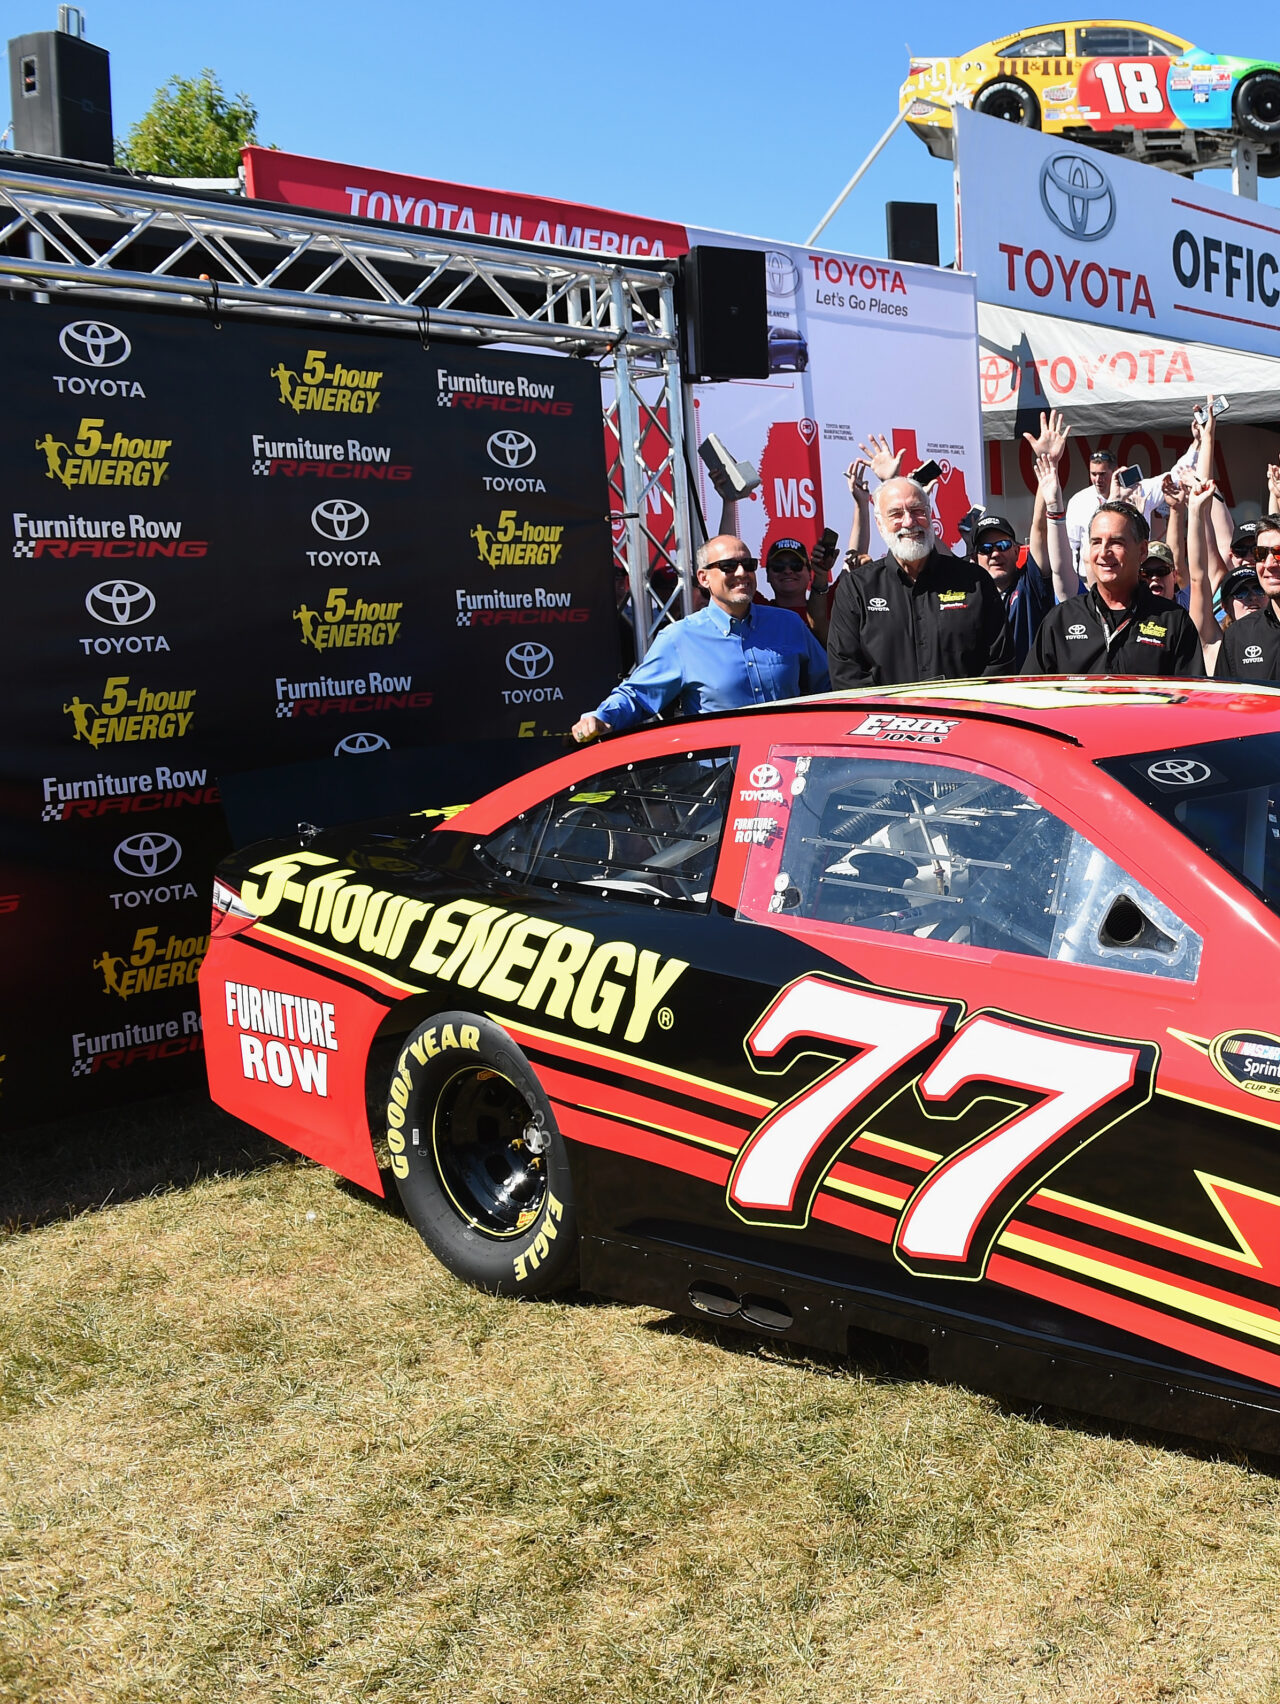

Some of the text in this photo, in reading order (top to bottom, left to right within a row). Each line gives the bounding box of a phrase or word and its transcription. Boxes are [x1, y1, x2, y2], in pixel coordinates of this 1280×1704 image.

[1095, 62, 1163, 114] 18
[345, 187, 476, 234] TOYOTA
[489, 212, 521, 240] IN
[809, 256, 907, 295] TOYOTA
[999, 243, 1156, 318] TOYOTA
[816, 289, 908, 317] Let's Go Places
[303, 350, 383, 389] 5-hour
[437, 369, 555, 399] Furniture Row
[1025, 347, 1195, 395] TOYOTA
[53, 376, 146, 399] TOYOTA
[296, 386, 380, 414] ENERGY
[451, 393, 573, 416] RACING
[75, 418, 172, 459] 5-hour
[252, 434, 391, 463] Furniture Row
[65, 459, 169, 487] ENERGY
[269, 460, 413, 481] RACING
[482, 477, 546, 493] TOYOTA
[774, 477, 817, 519] MS
[13, 513, 182, 540] Furniture Row
[497, 510, 563, 543] 5-hour
[34, 540, 209, 558] RACING
[306, 551, 381, 567] TOYOTA
[489, 541, 561, 568] ENERGY
[324, 588, 403, 622] 5-hour
[456, 590, 571, 610] Furniture Row
[471, 608, 590, 627] RACING
[80, 636, 171, 655] TOYOTA
[316, 619, 401, 649] ENERGY
[1242, 657, 1263, 665] TOYOTA
[101, 677, 196, 716] 5-hour
[276, 673, 412, 700] Furniture Row
[502, 687, 564, 704] TOYOTA
[292, 692, 433, 718] RACING
[92, 712, 193, 745] ENERGY
[875, 733, 947, 744] JONES
[43, 766, 207, 802] Furniture Row
[740, 790, 784, 803] TOYOTA
[735, 829, 770, 844] ROW
[109, 883, 198, 909] TOYOTA
[131, 926, 211, 966] 5-hou
[240, 851, 690, 1043] 5-hour ENERGY
[119, 957, 203, 995] ENERG
[225, 981, 338, 1051] FURNITURE
[72, 1020, 179, 1057] Furniture
[92, 1034, 203, 1074] RACI
[239, 1033, 328, 1097] ROW
[1244, 1082, 1267, 1091] CUP
[729, 975, 1142, 1264] 77
[514, 1190, 563, 1283] EAGLE
